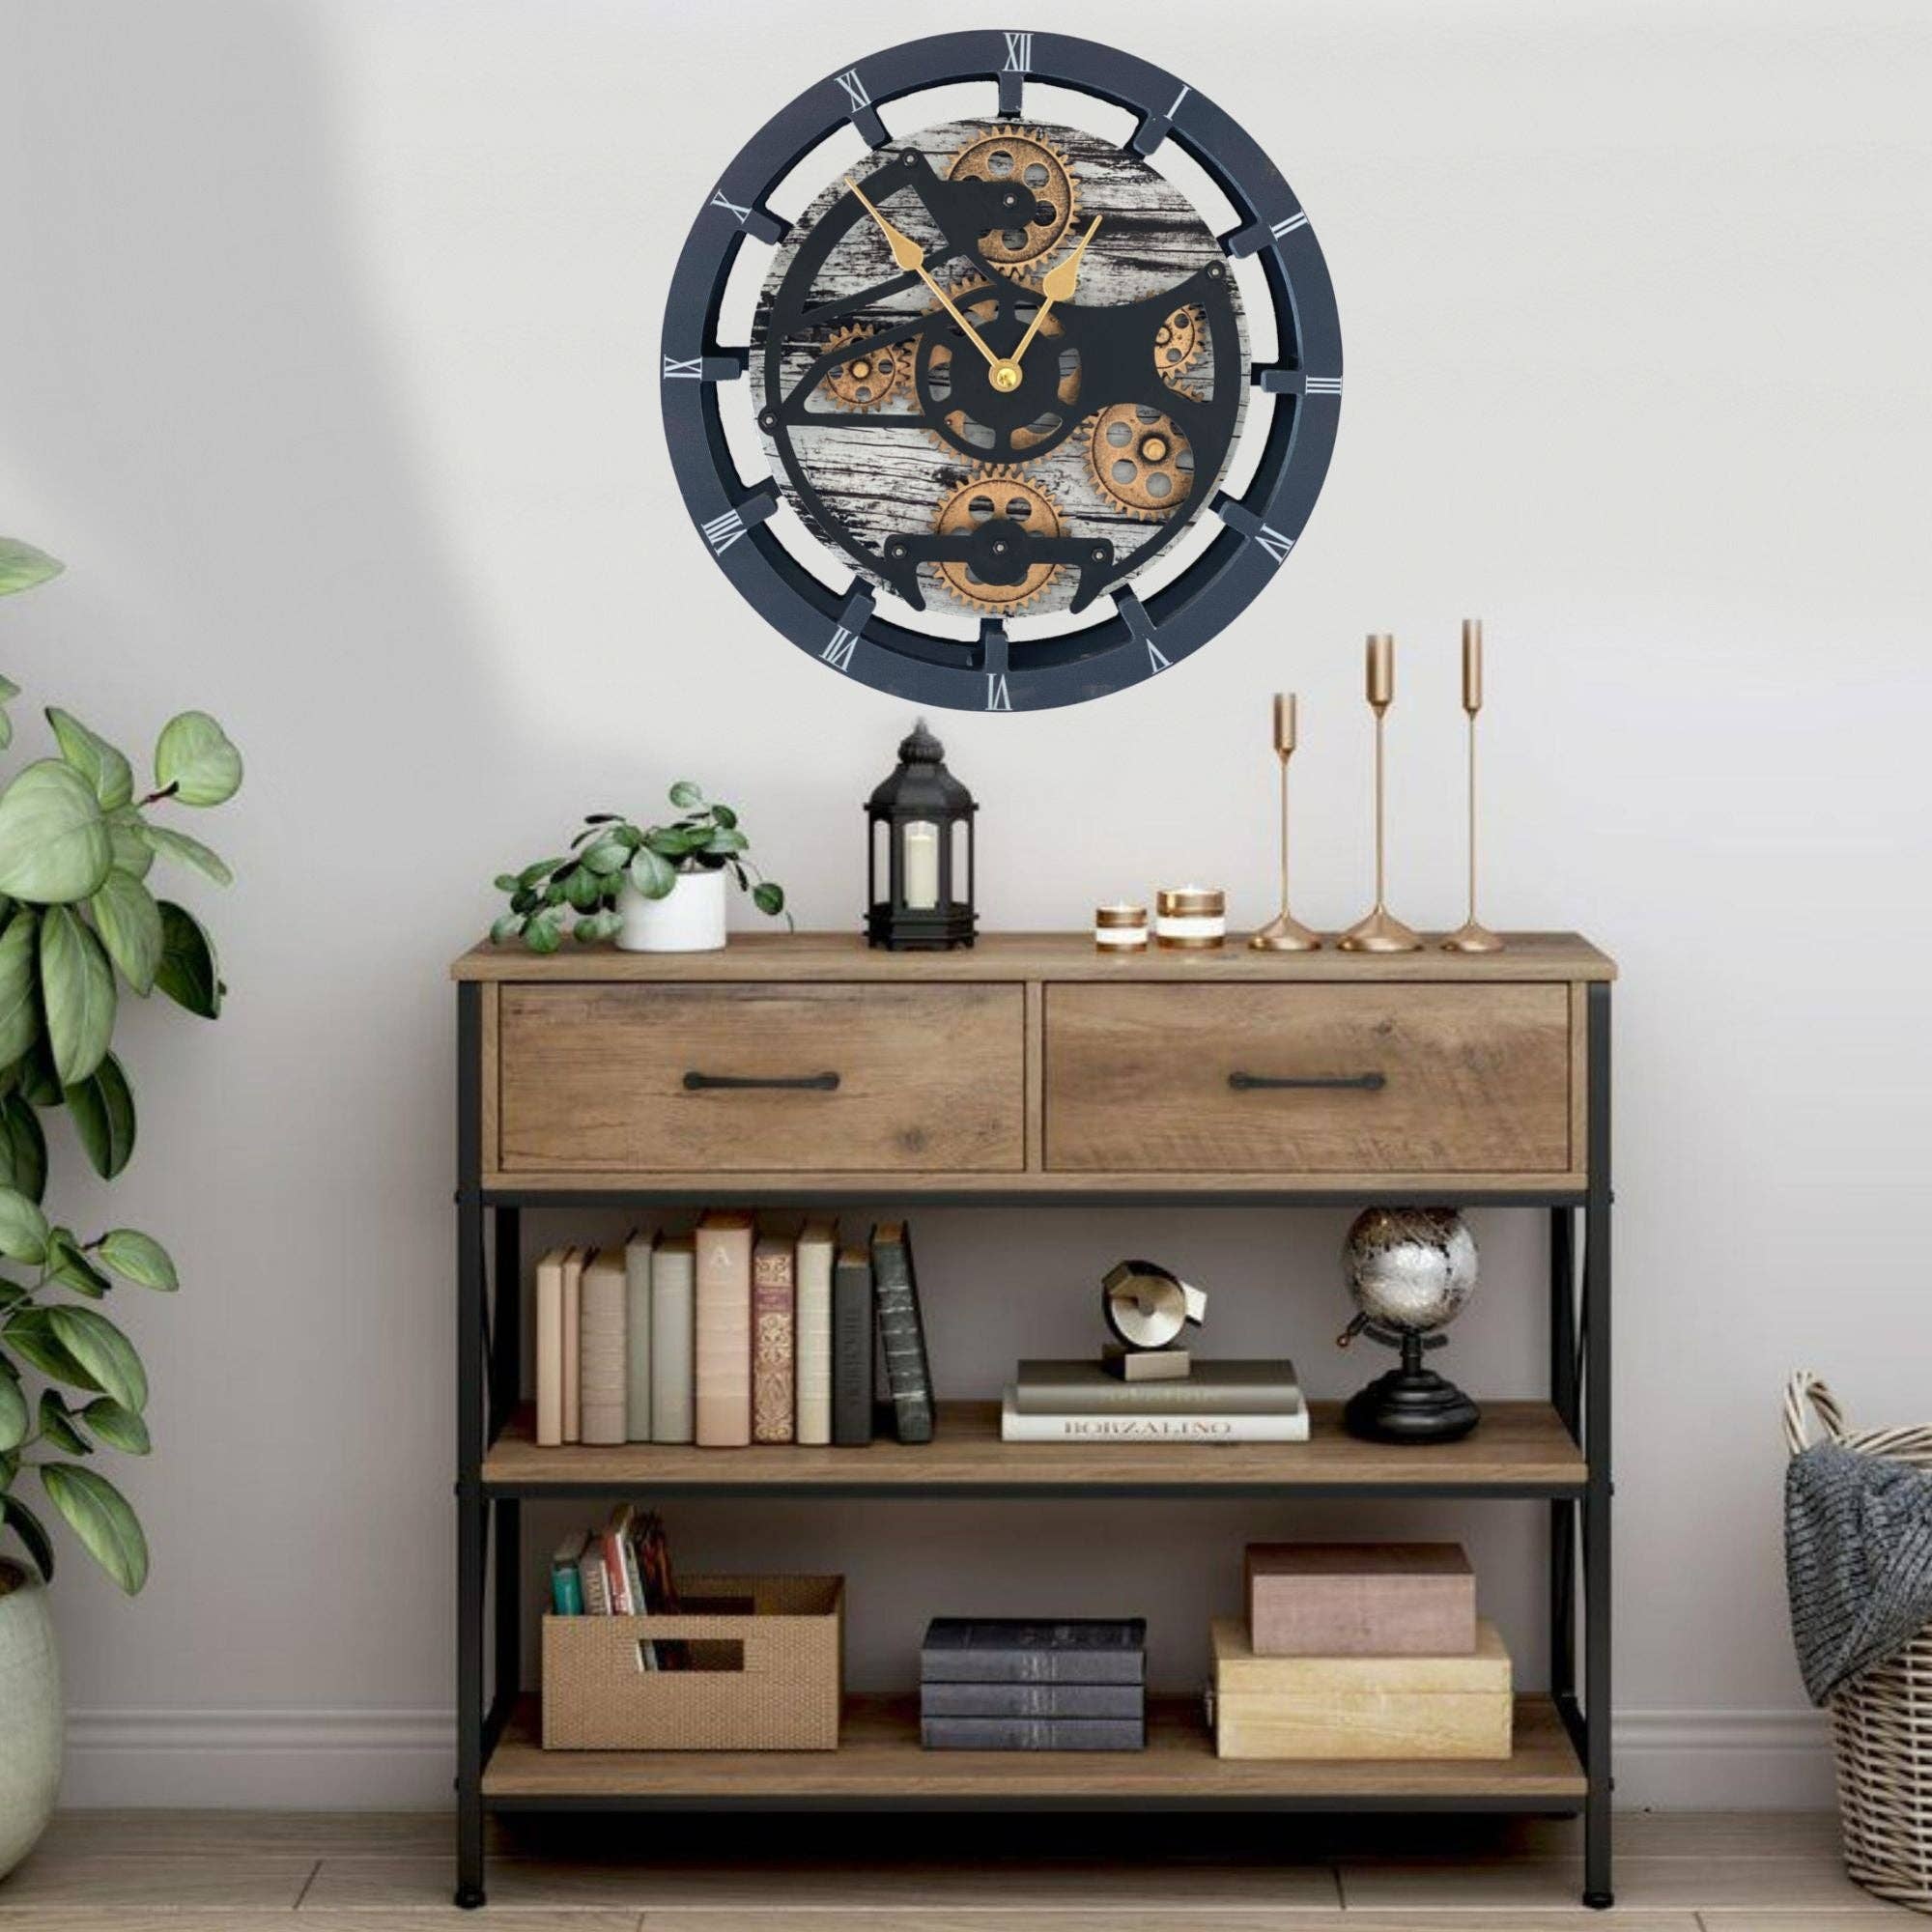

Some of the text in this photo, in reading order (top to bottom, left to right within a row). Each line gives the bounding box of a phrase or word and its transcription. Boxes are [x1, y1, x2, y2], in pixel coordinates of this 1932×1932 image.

[1003, 32, 1035, 72] XII
[834, 68, 871, 113] XI
[1163, 84, 1192, 122] I
[710, 189, 753, 225] X
[1269, 211, 1309, 242] II
[663, 354, 703, 380] IX
[1305, 374, 1343, 396] III
[700, 508, 748, 557] VIII
[1255, 523, 1296, 566] IV
[818, 624, 859, 673] VII
[1146, 638, 1174, 674] V
[985, 673, 1013, 711] VI
